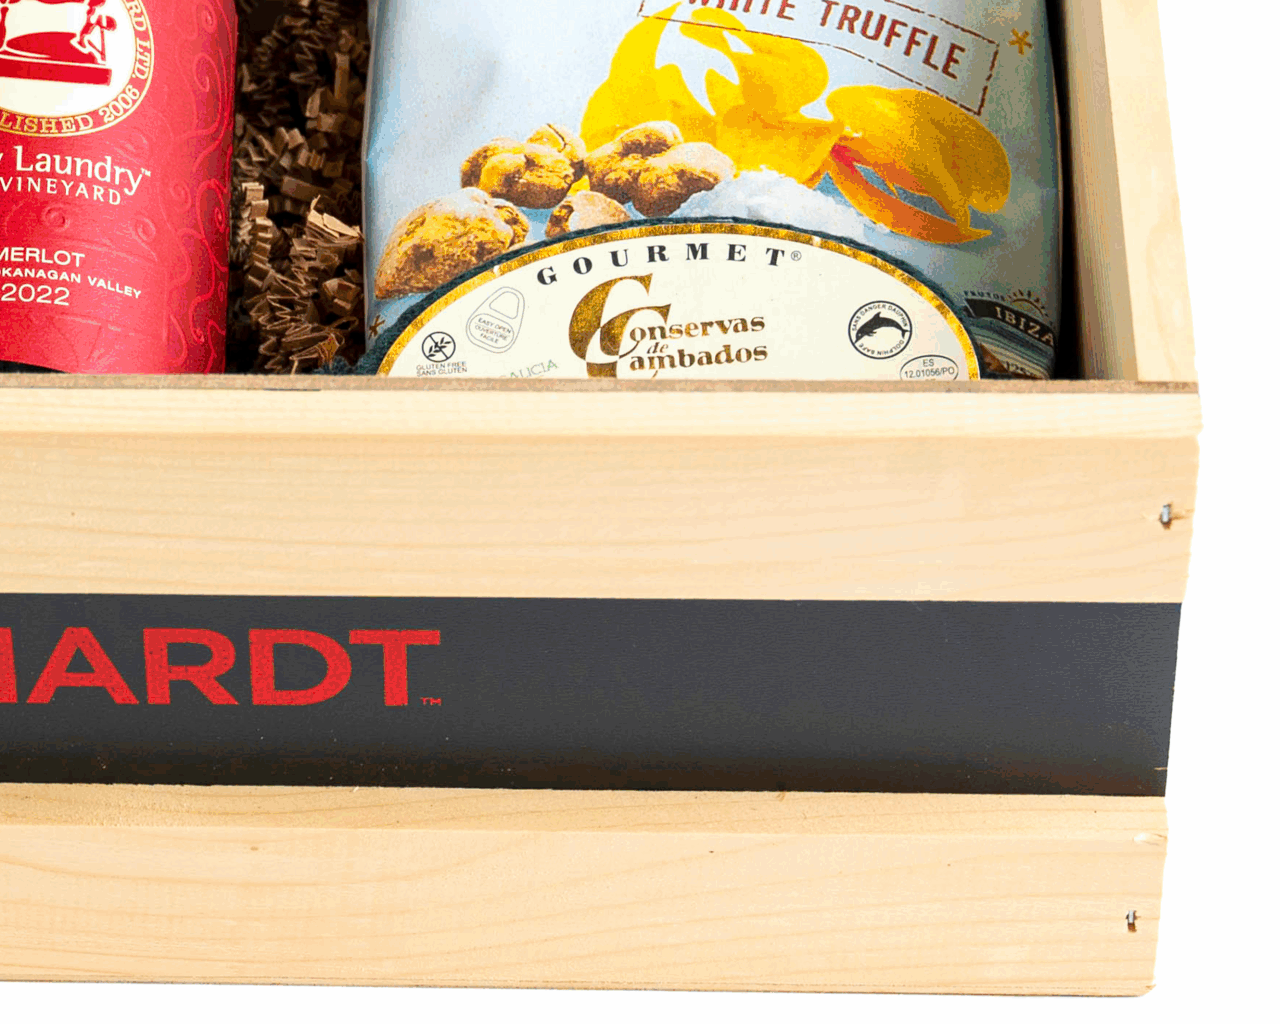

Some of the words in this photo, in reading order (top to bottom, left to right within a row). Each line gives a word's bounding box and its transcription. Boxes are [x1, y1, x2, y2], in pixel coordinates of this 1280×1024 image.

[132, 37, 151, 80] LTD.
[98, 84, 140, 123] 2006
[0, 176, 121, 206] VINEYARD
[536, 242, 785, 286] GOURMET
[0, 283, 70, 306] 2022
[87, 275, 142, 299] VALLEY
[478, 317, 494, 328] EASY
[494, 323, 512, 334] OPEN
[995, 306, 1054, 347] IBIZA
[646, 342, 669, 354] de
[416, 362, 446, 371] GLUTEN
[447, 361, 467, 369] FREE
[438, 367, 468, 376] GLUTEN
[922, 358, 935, 367] ES
